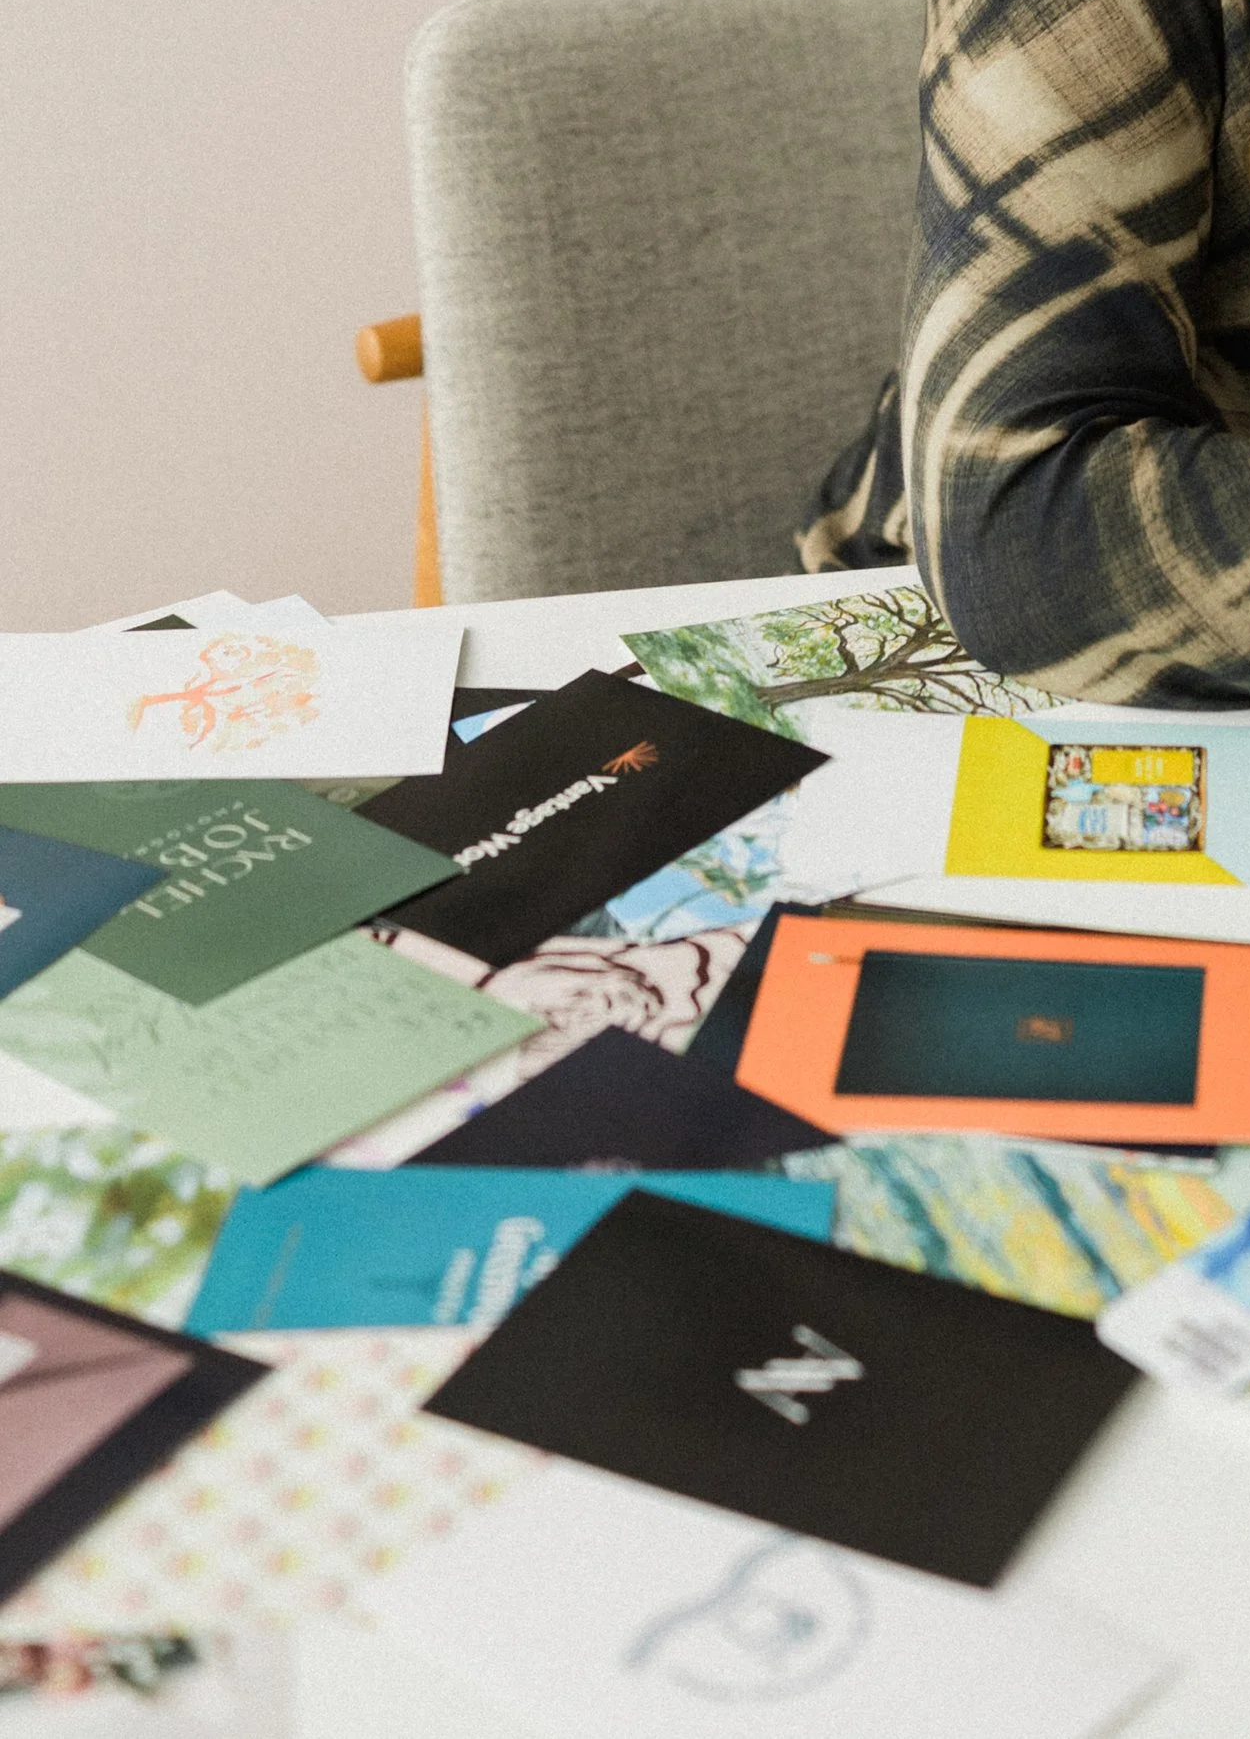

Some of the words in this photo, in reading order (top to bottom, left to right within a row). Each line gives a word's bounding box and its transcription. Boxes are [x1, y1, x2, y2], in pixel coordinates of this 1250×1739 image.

[122, 800, 245, 860] PHOTOGR
[505, 774, 620, 835] Vantage
[120, 827, 313, 920] RACHEL
[452, 832, 522, 875] Wor
